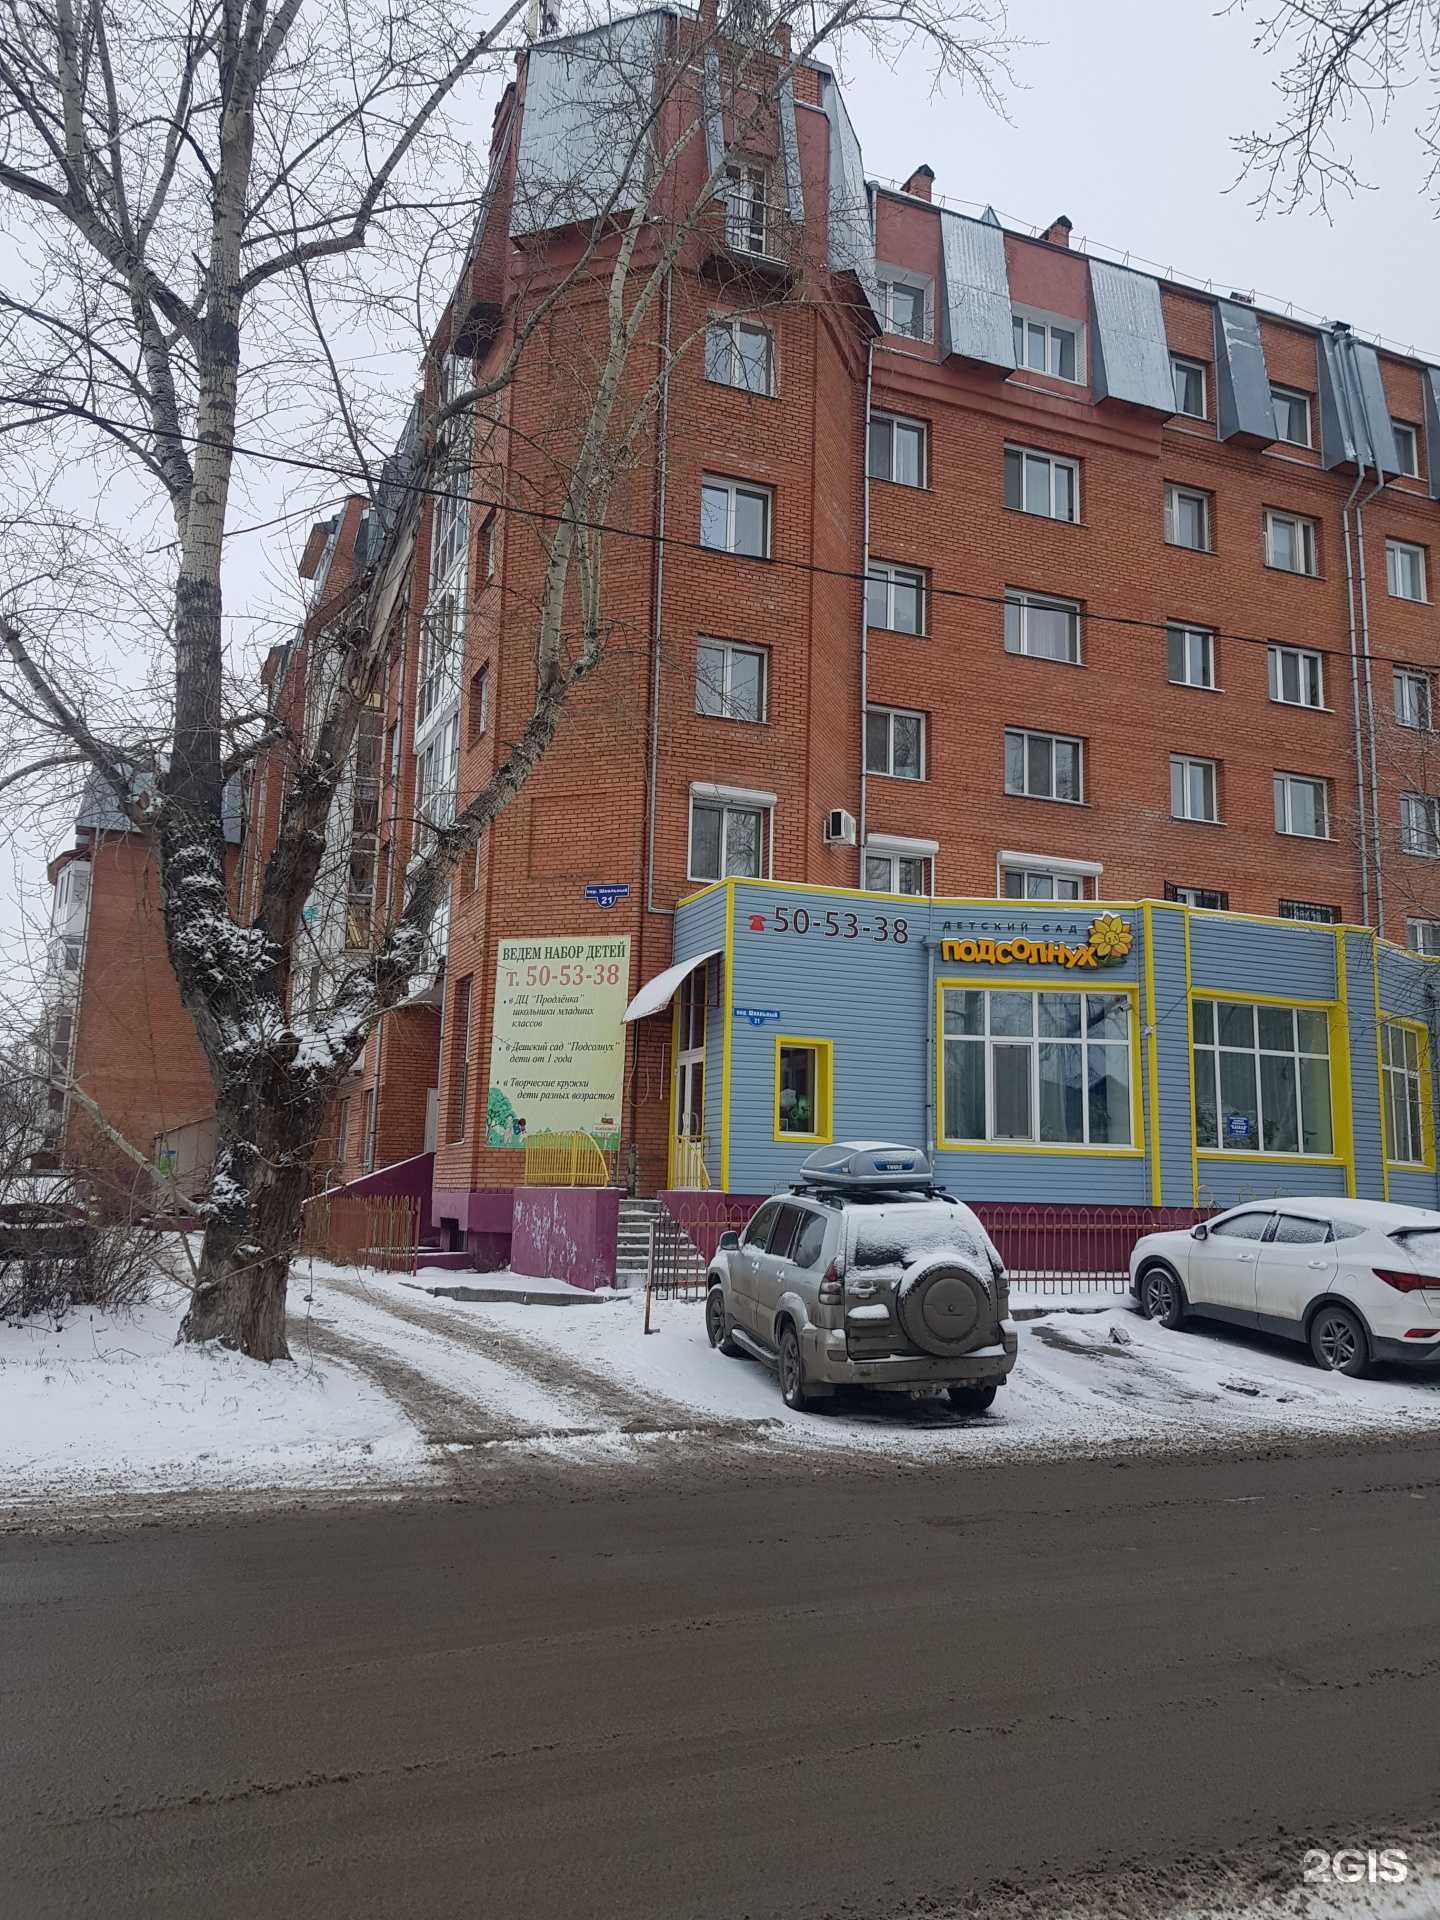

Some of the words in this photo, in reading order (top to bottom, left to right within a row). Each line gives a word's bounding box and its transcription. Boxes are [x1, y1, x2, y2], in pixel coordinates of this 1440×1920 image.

[601, 896, 613, 905] 21
[774, 906, 909, 945] 50-53-38
[943, 921, 1029, 932] ДЕТСКИЙ
[1042, 923, 1078, 934] САД
[502, 946, 542, 963] ВЕДЕМ
[545, 945, 584, 960] НАБОР
[586, 941, 626, 961] ДЕТЕЙ
[941, 937, 1098, 970] ПОДСОЛНУХ
[526, 964, 620, 987] 50-53-38
[514, 994, 528, 1006] ДЦ
[512, 1007, 556, 1016] школьники
[557, 1006, 595, 1016] младших
[512, 1019, 543, 1028] классов
[511, 1041, 547, 1052] Детский
[549, 1041, 564, 1051] сад
[509, 1055, 531, 1064] дети
[547, 1054, 552, 1064] 1
[553, 1055, 573, 1064] года
[510, 1078, 555, 1090] Творческие
[557, 1079, 589, 1090] кружки
[517, 1090, 539, 1099] дети
[540, 1092, 569, 1102] разных
[571, 1091, 615, 1102] возрастов
